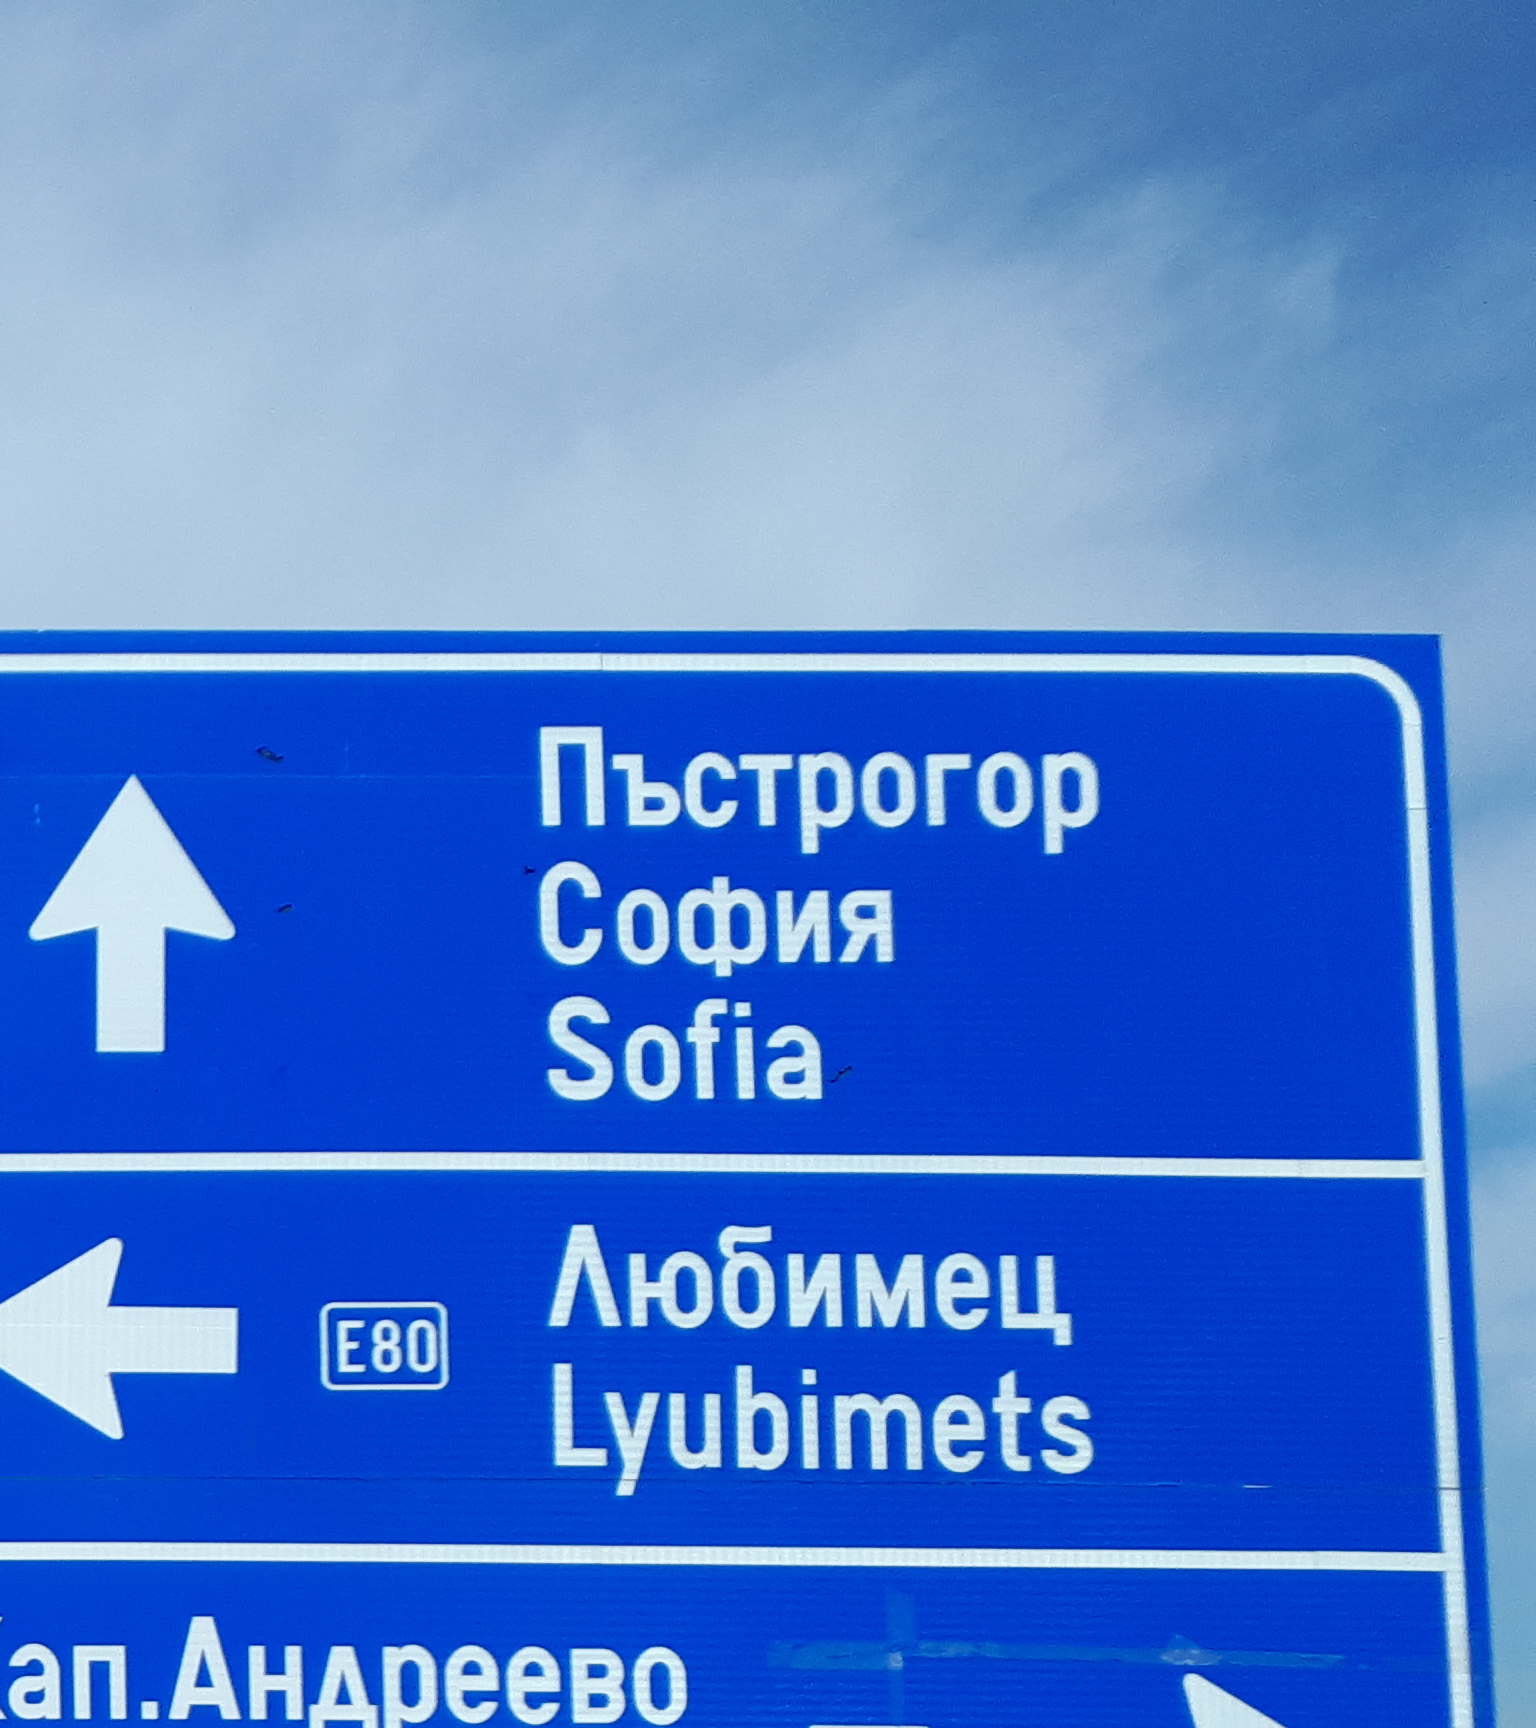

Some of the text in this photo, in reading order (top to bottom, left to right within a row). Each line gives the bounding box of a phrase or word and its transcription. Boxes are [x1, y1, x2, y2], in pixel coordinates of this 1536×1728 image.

[539, 725, 1100, 855] Пъстрогор
[538, 860, 895, 978] София
[546, 994, 824, 1102] Sofia
[547, 1223, 1073, 1347] Любимец
[336, 1318, 439, 1374] E80
[552, 1362, 1094, 1497] Lyubimets
